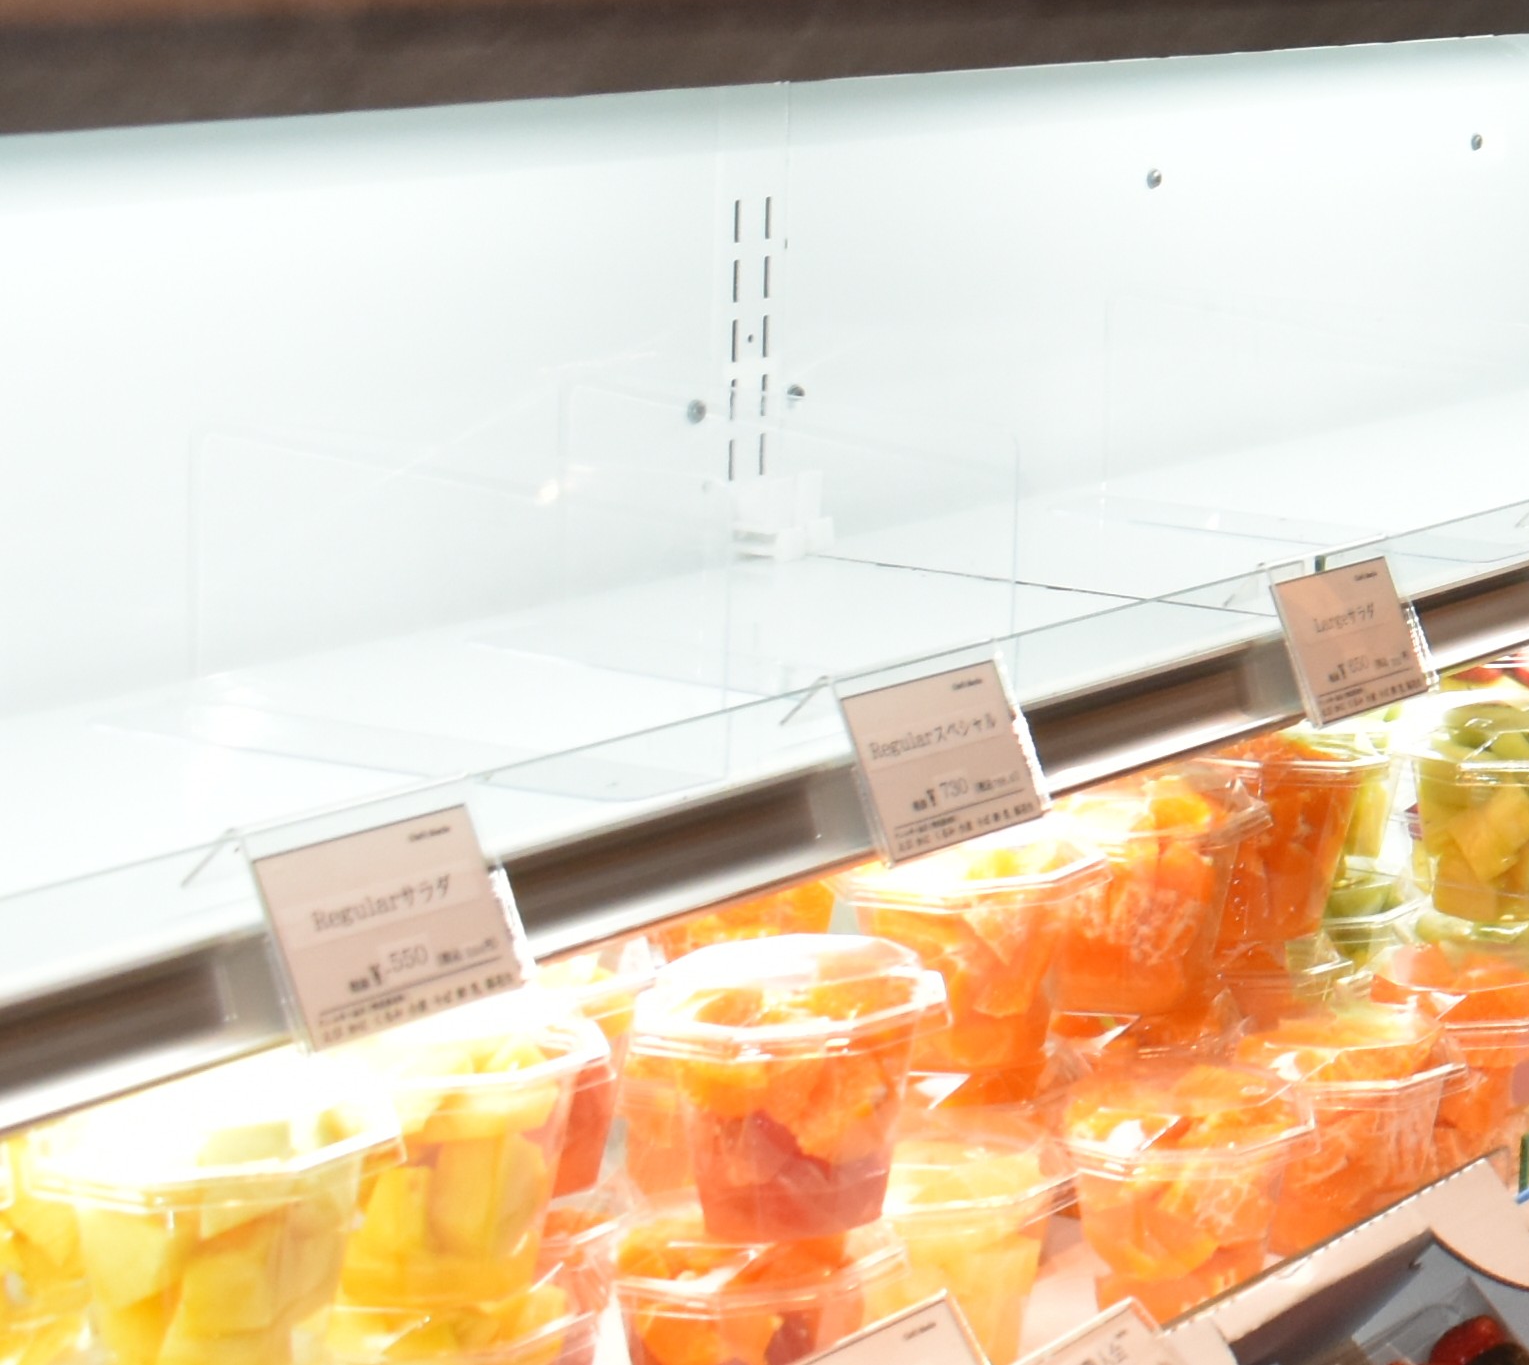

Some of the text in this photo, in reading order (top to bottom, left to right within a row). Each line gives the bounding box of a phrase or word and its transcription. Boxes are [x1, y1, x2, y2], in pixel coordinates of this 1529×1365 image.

[868, 711, 998, 761] Regularスペシャル
[310, 874, 452, 933] Regularサラダ
